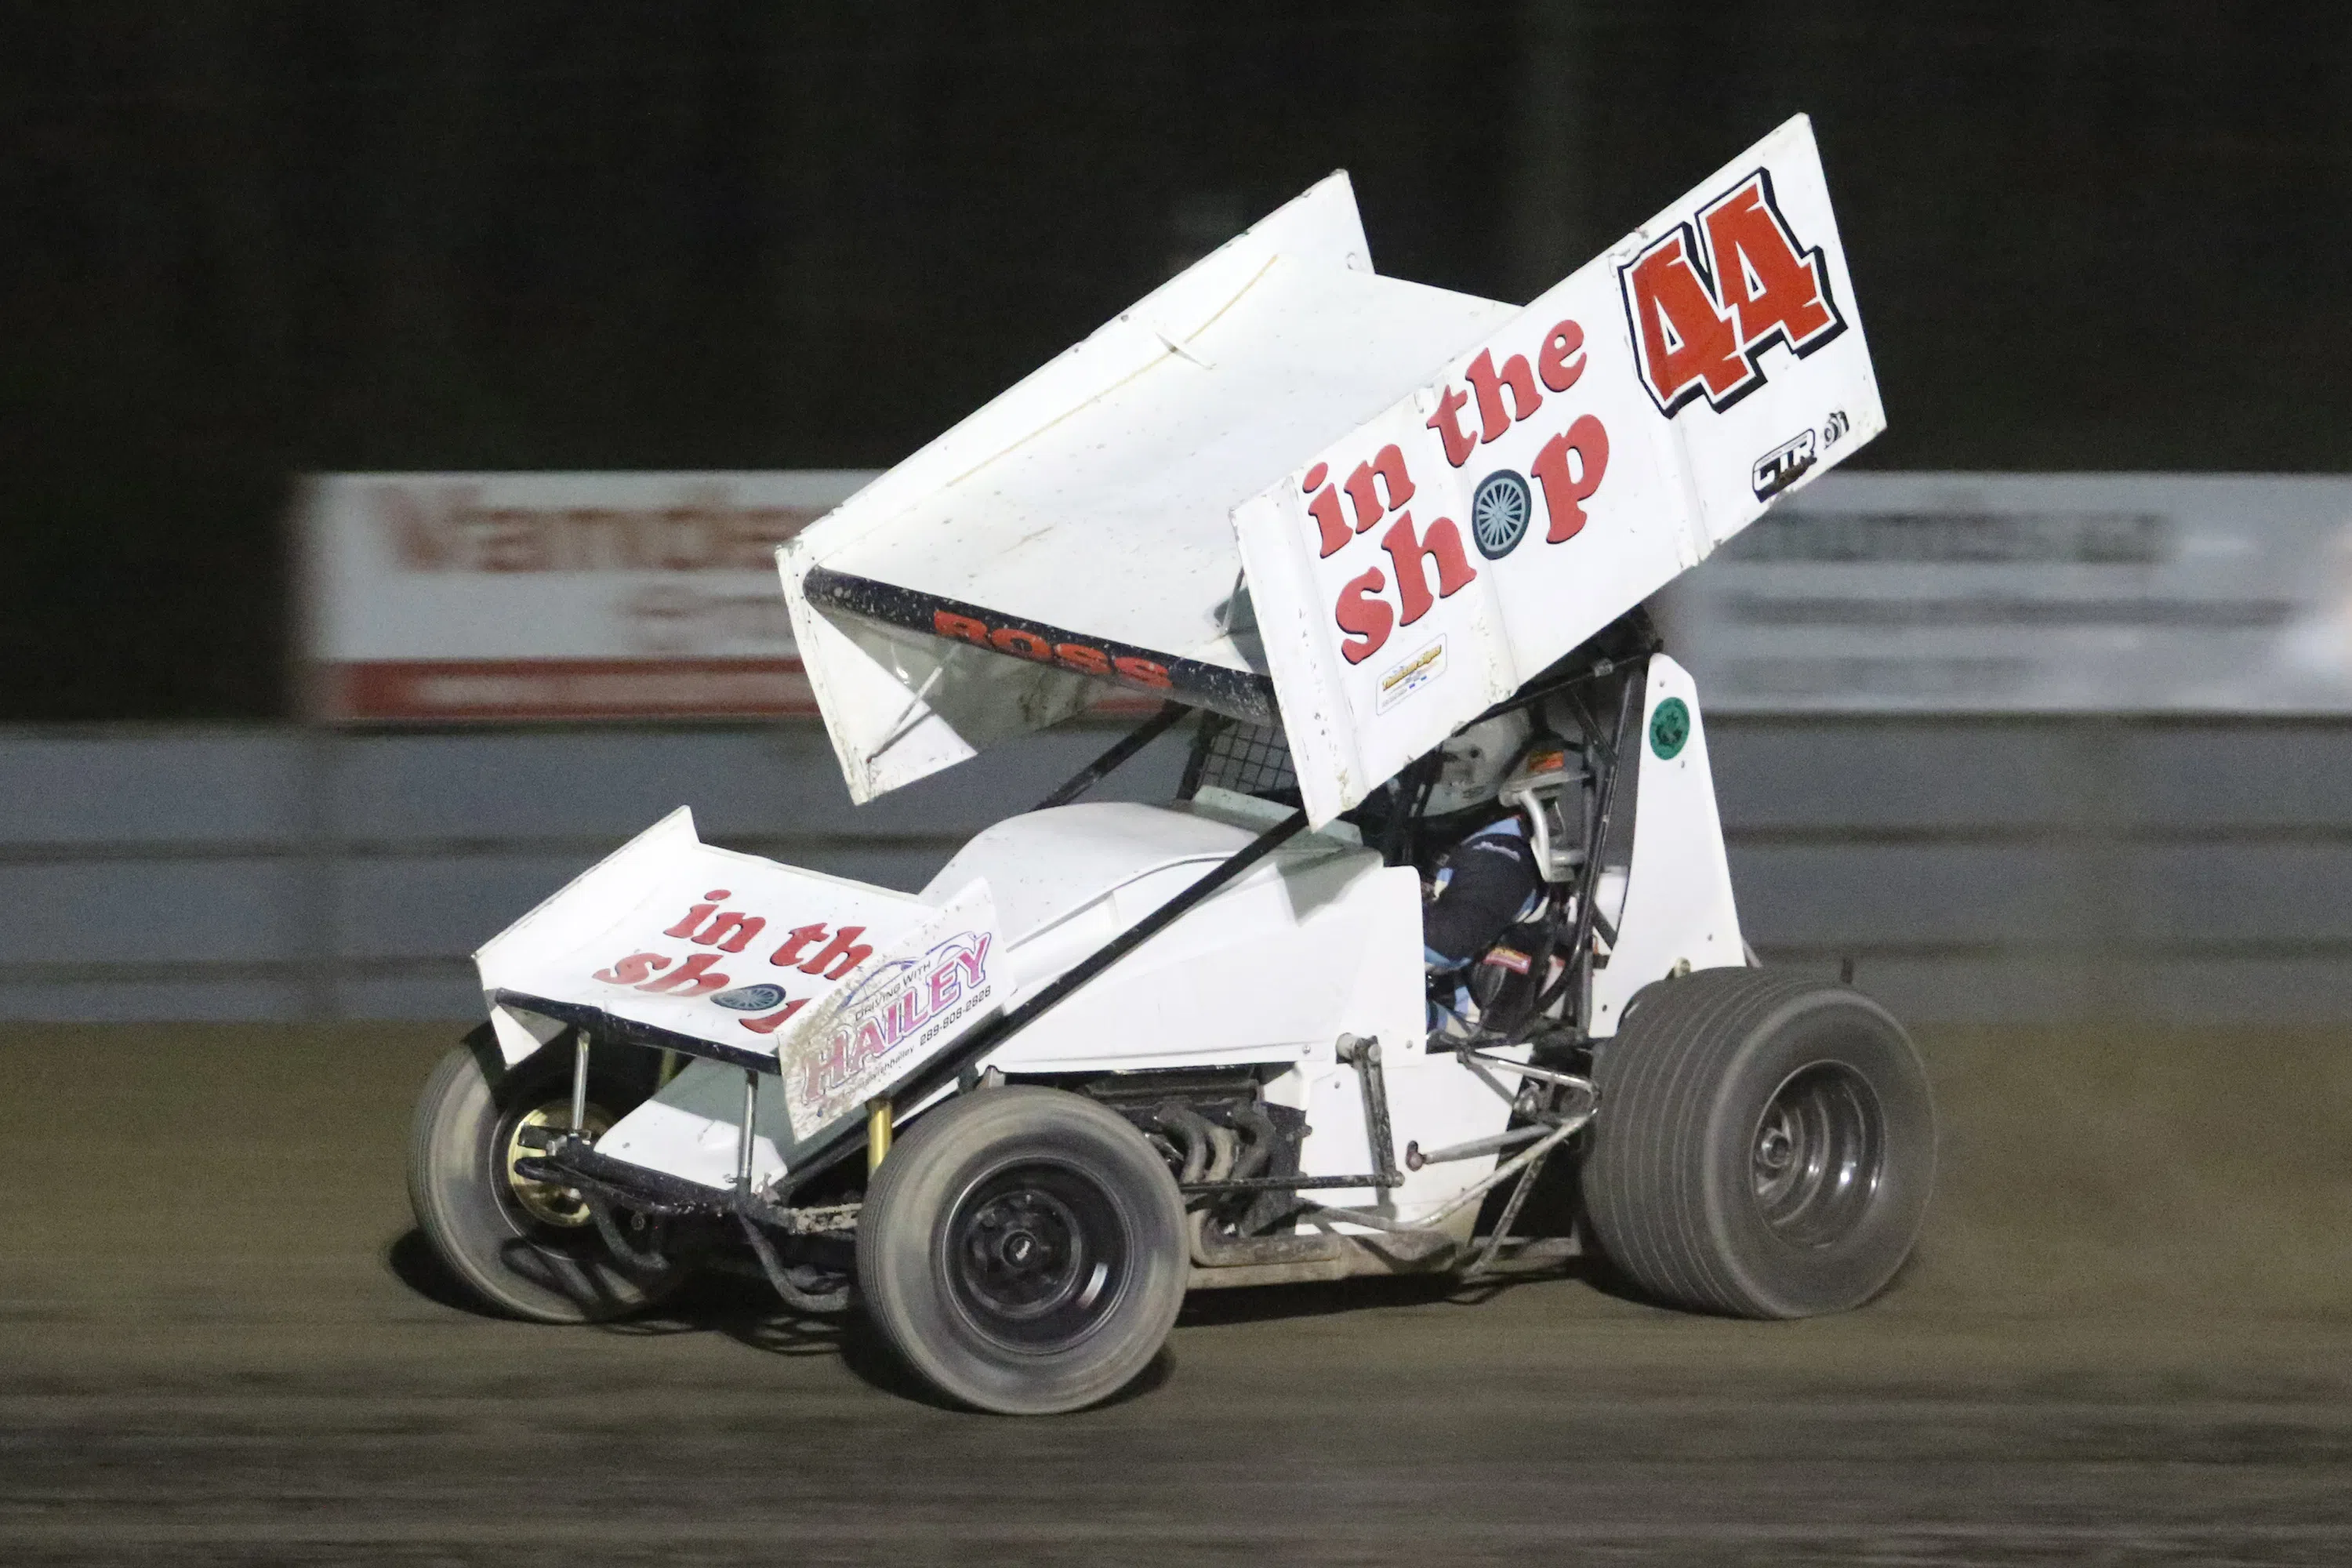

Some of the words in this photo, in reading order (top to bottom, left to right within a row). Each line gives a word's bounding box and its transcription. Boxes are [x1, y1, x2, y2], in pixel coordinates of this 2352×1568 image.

[1618, 166, 1848, 419] 44
[1302, 442, 1415, 559] in
[1426, 318, 1588, 469] the
[663, 889, 767, 953] in
[769, 922, 873, 981] th
[801, 933, 992, 1105] HAILEY
[855, 983, 901, 1022] DRIVING
[903, 960, 931, 987] WITH
